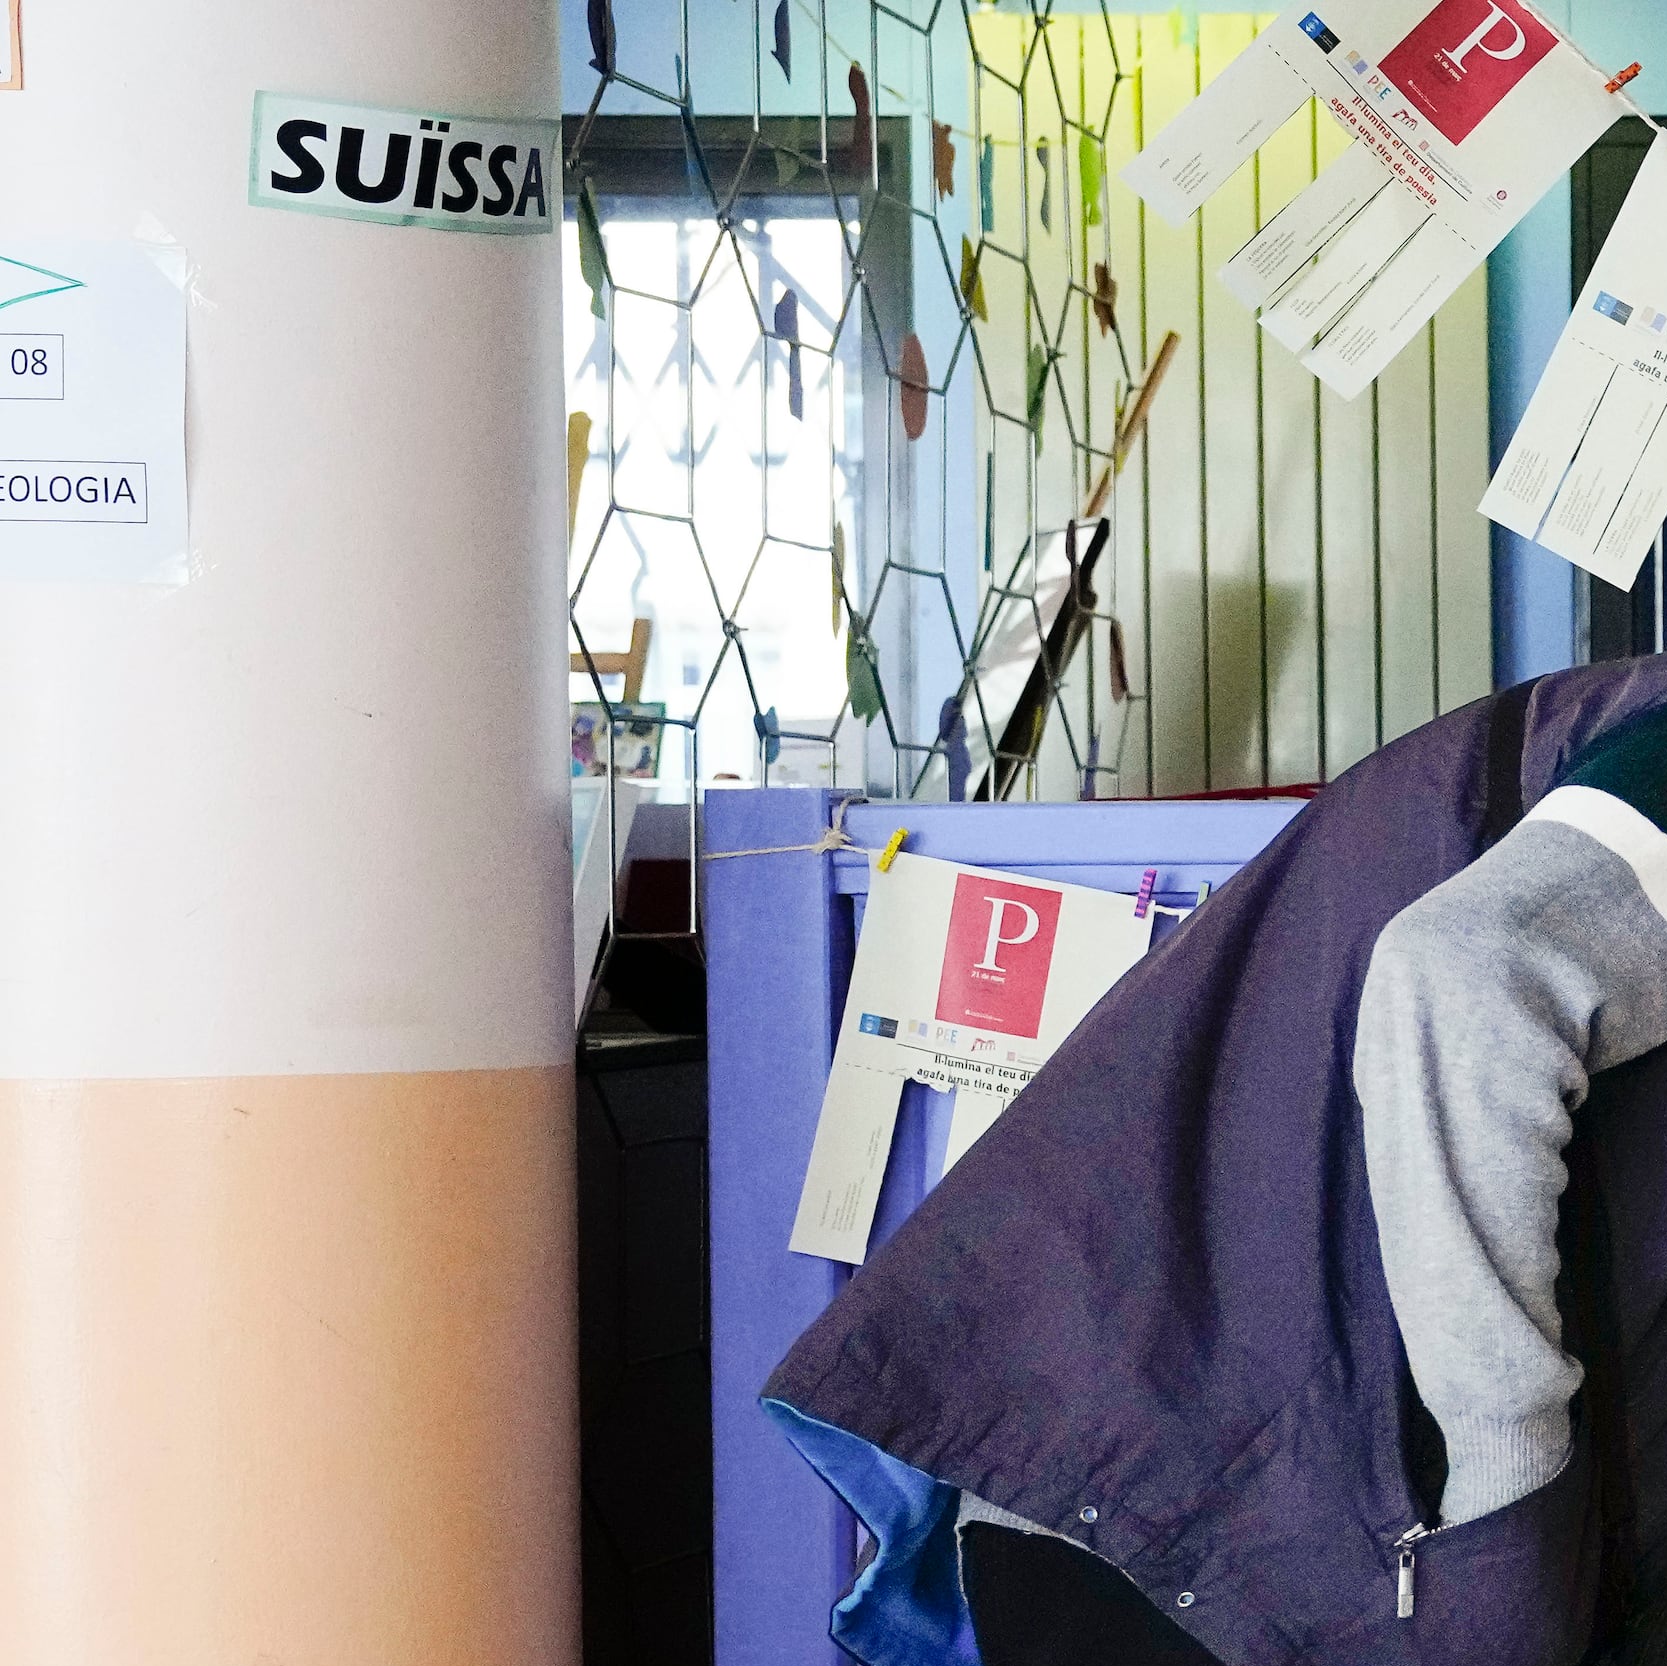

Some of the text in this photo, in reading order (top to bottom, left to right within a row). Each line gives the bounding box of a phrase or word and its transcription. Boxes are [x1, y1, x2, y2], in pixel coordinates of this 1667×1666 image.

[1442, 0, 1526, 73] P
[1332, 98, 1437, 205] agafa una tira de poesia
[1392, 138, 1403, 150] el
[1402, 149, 1419, 166] teu
[271, 119, 546, 216] SUÏSSA
[11, 348, 48, 376] 08
[1633, 360, 1661, 378] agafa
[974, 896, 1040, 972] P
[917, 1067, 944, 1082] agafa
[974, 1079, 992, 1090] tira
[996, 1082, 1009, 1094] de
[985, 1064, 996, 1074] el
[999, 1067, 1016, 1079] teu
[1020, 1069, 1034, 1082] di
